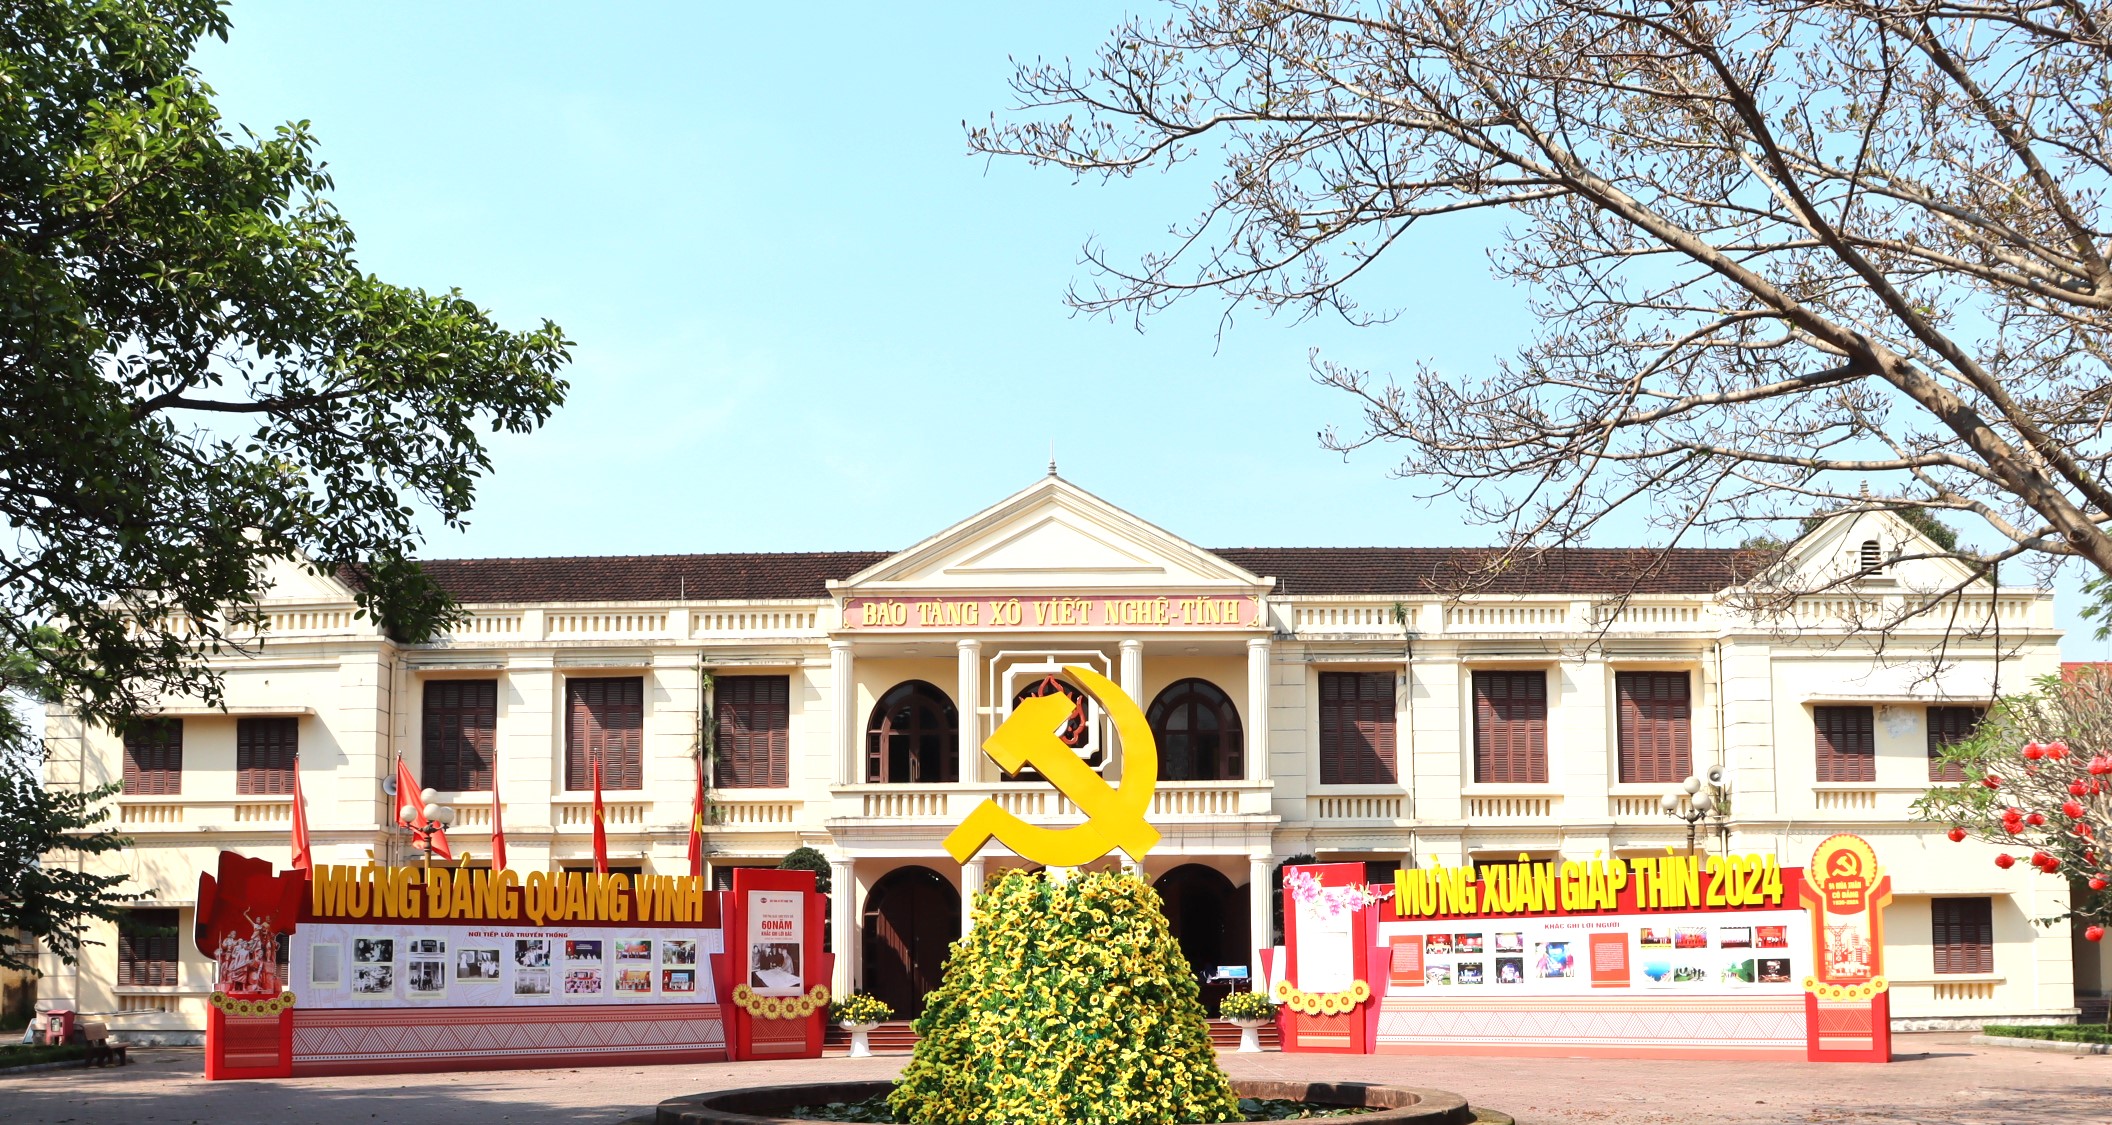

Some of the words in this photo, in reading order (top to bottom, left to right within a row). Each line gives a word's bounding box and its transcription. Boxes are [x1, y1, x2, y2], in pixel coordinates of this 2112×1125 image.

[862, 598, 907, 626] BẢO
[917, 598, 979, 626] TÀNG
[989, 598, 1022, 626] XÔ
[1033, 597, 1092, 625] VIẾT
[312, 849, 421, 919] MỪNG
[426, 851, 519, 920] ĐẢNG
[525, 870, 629, 926] QUANG
[634, 873, 704, 922] VINH
[1394, 853, 1477, 916] MỪNG
[1480, 852, 1556, 913] XUÂN
[1560, 849, 1627, 910] GIÁP
[1631, 845, 1700, 908] THÌN
[1706, 853, 1783, 907] 2024
